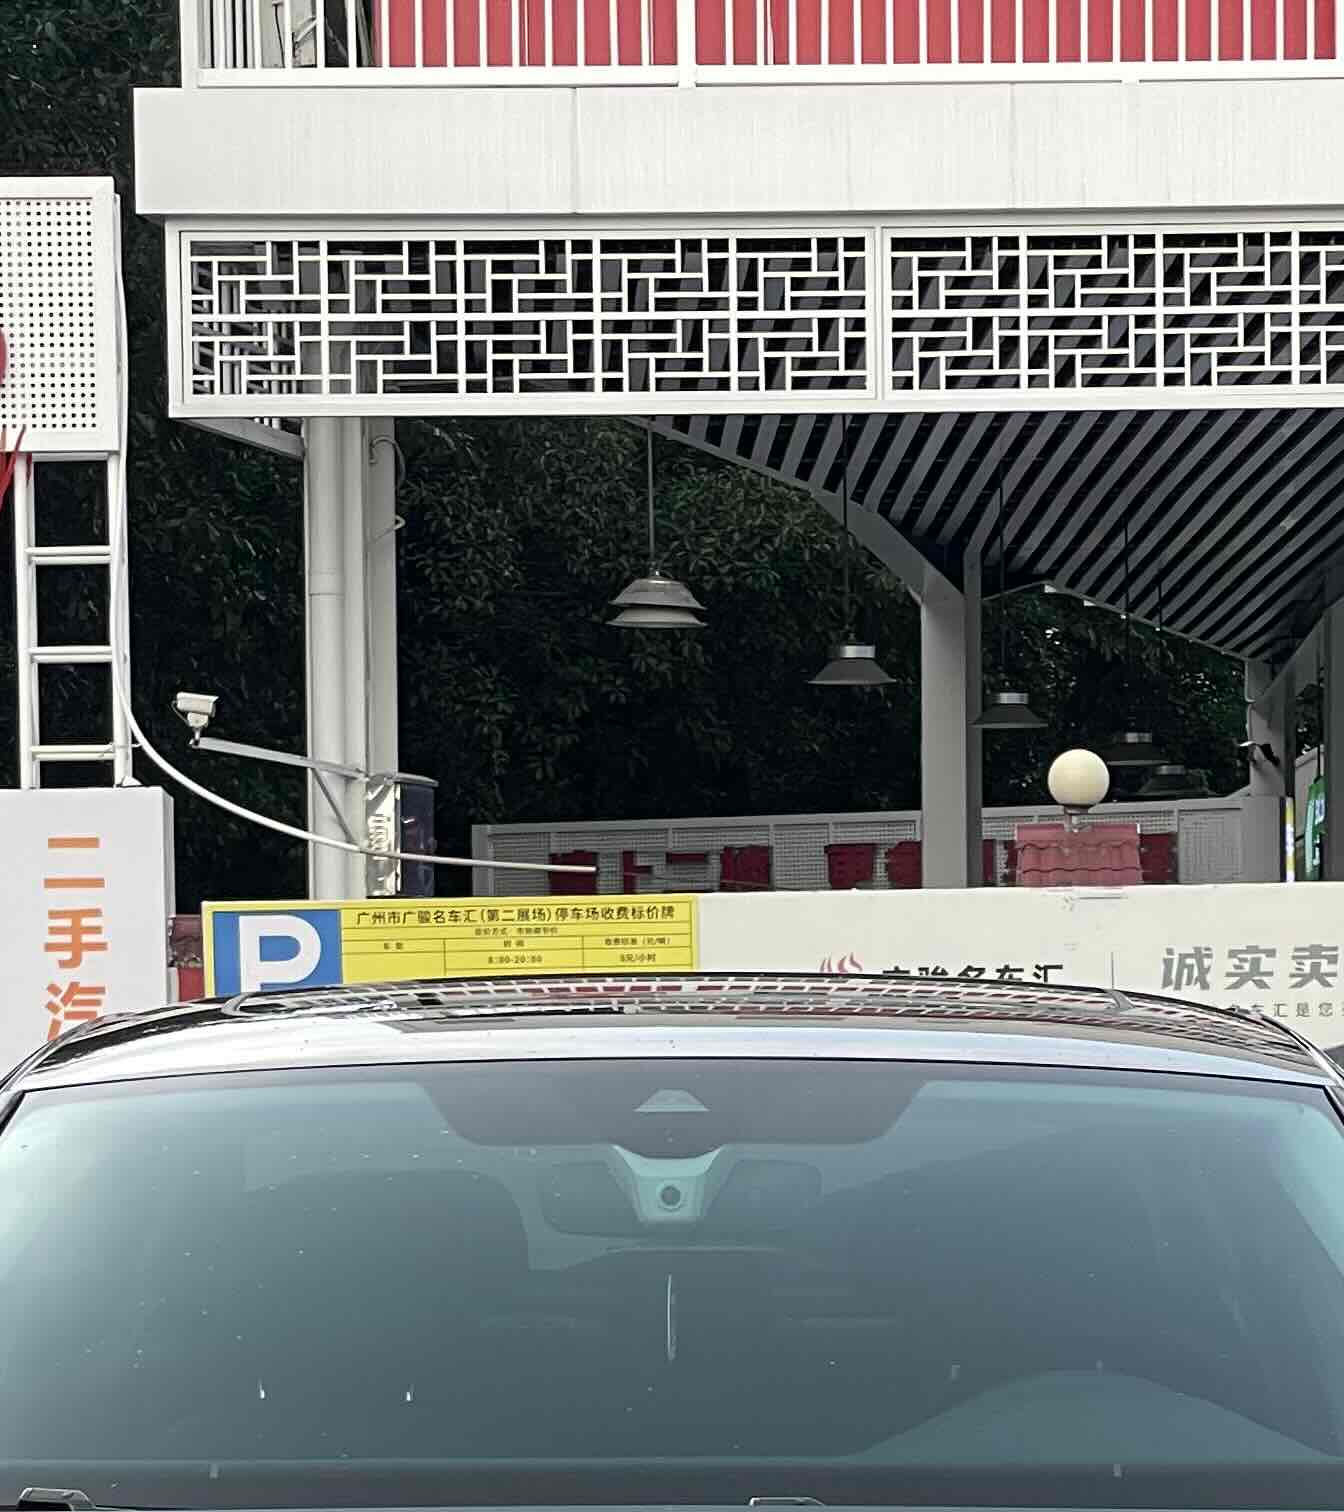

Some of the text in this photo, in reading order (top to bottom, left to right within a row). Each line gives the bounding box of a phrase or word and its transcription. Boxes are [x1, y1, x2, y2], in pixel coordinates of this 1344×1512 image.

[239, 915, 321, 993] P
[1161, 943, 1340, 992] 诚实卖
